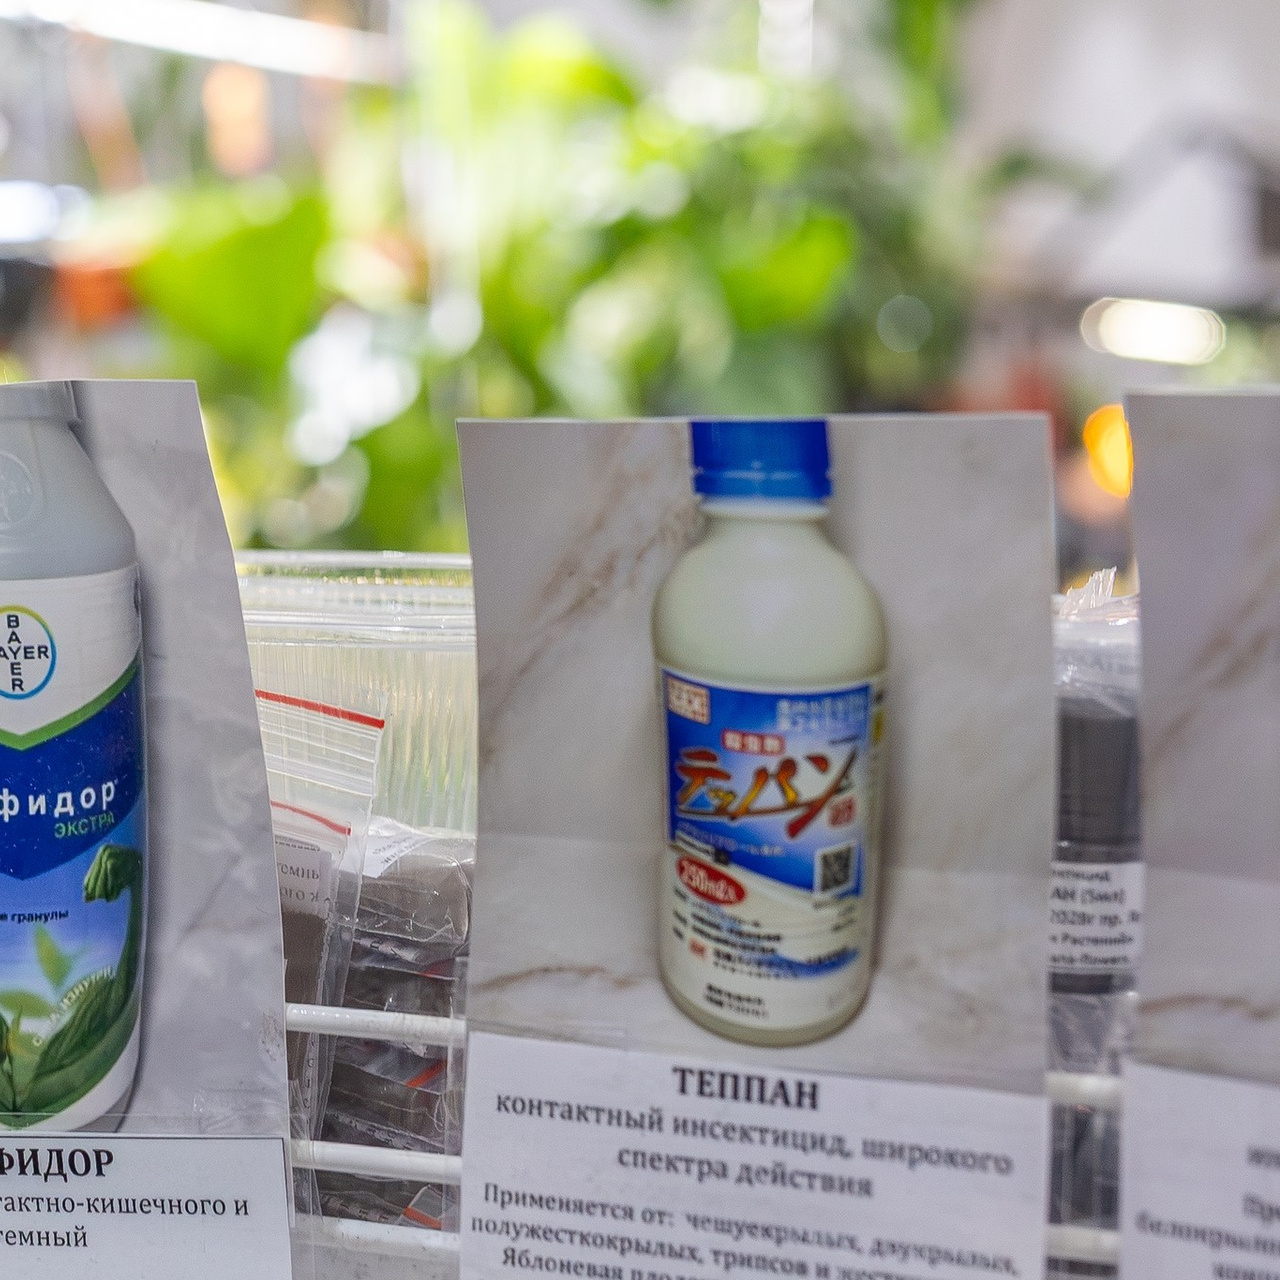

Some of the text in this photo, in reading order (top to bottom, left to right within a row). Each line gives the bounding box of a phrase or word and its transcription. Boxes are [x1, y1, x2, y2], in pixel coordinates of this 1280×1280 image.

[6, 613, 25, 692] BAYER
[672, 1066, 819, 1111] ТЕППАН
[234, 1199, 249, 1216] и
